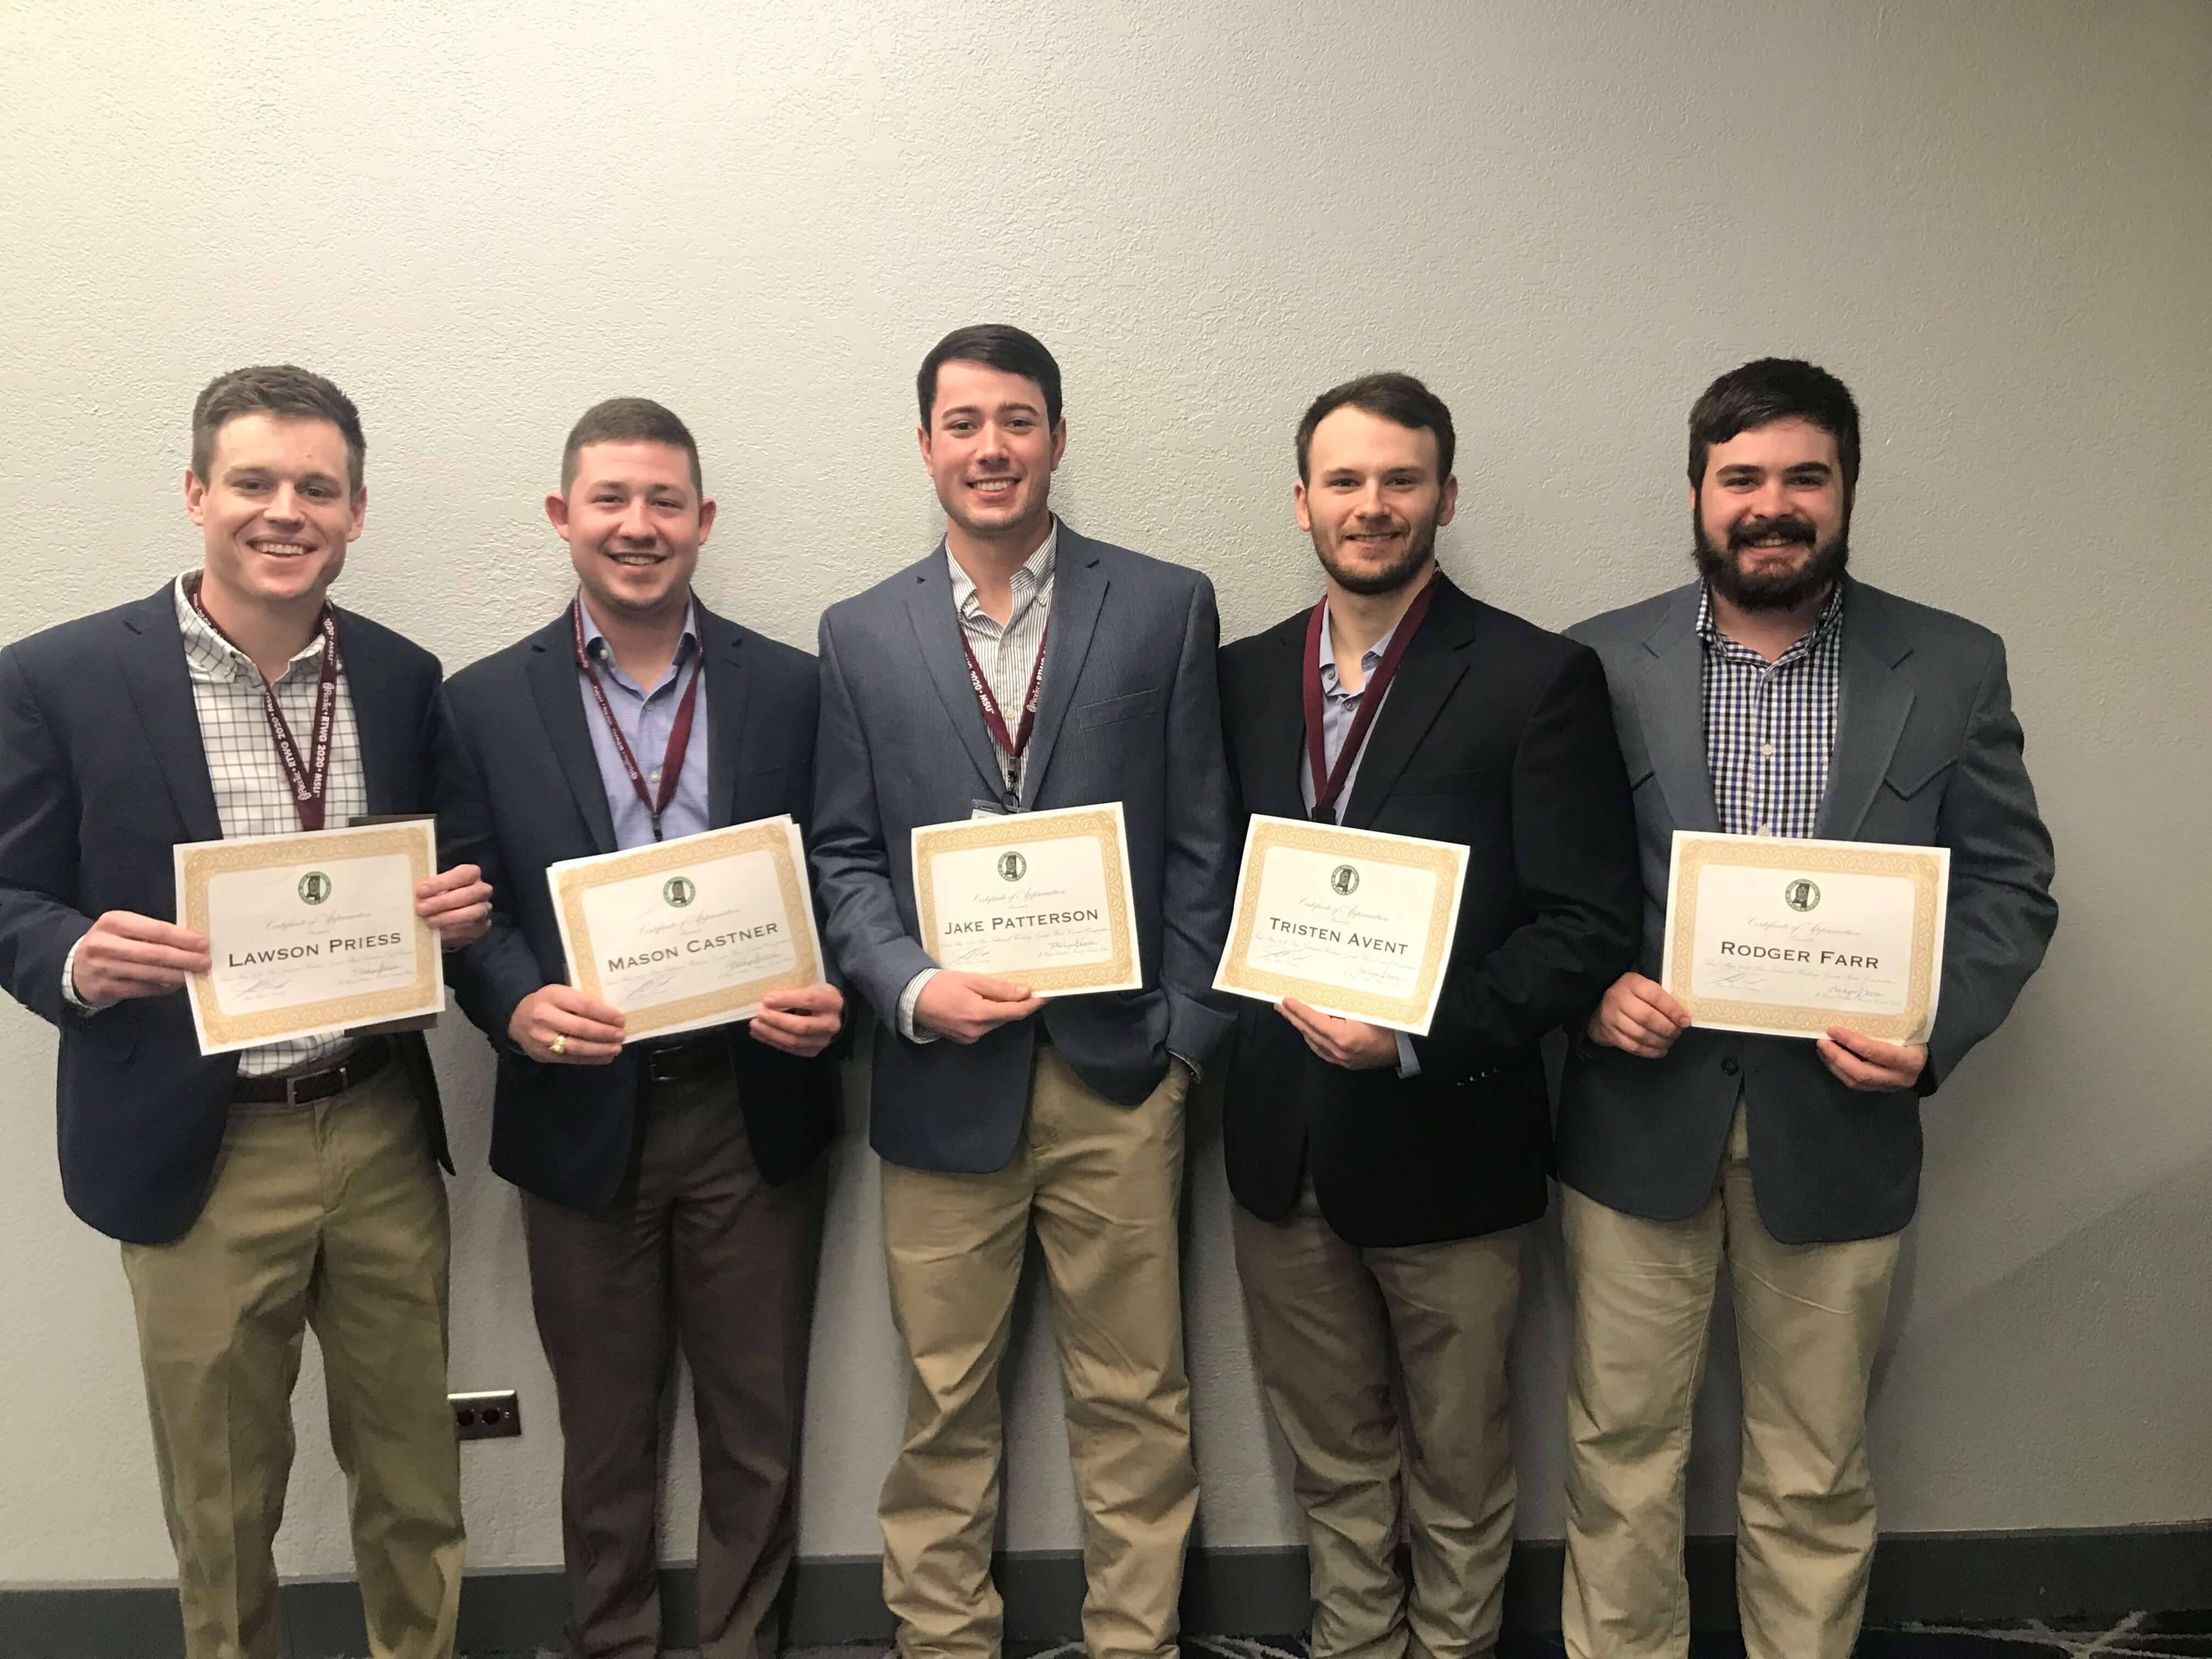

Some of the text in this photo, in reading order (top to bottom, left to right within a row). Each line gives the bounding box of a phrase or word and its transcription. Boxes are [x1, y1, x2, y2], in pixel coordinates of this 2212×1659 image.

[979, 694, 993, 712] MSU
[272, 716, 286, 739] 2020
[319, 716, 329, 742] RTWG
[281, 741, 296, 767] RTWG
[315, 744, 326, 768] 2020
[944, 909, 1098, 934] JAKE PATTERSON
[608, 946, 679, 972] MASON
[686, 922, 778, 953] CASTNER
[1269, 917, 1341, 943] TRISTEN
[1347, 933, 1408, 955] AVENT
[229, 944, 319, 967] LAWSON
[329, 932, 401, 953] PRIESS
[1720, 941, 1880, 969] RODGER FARR
